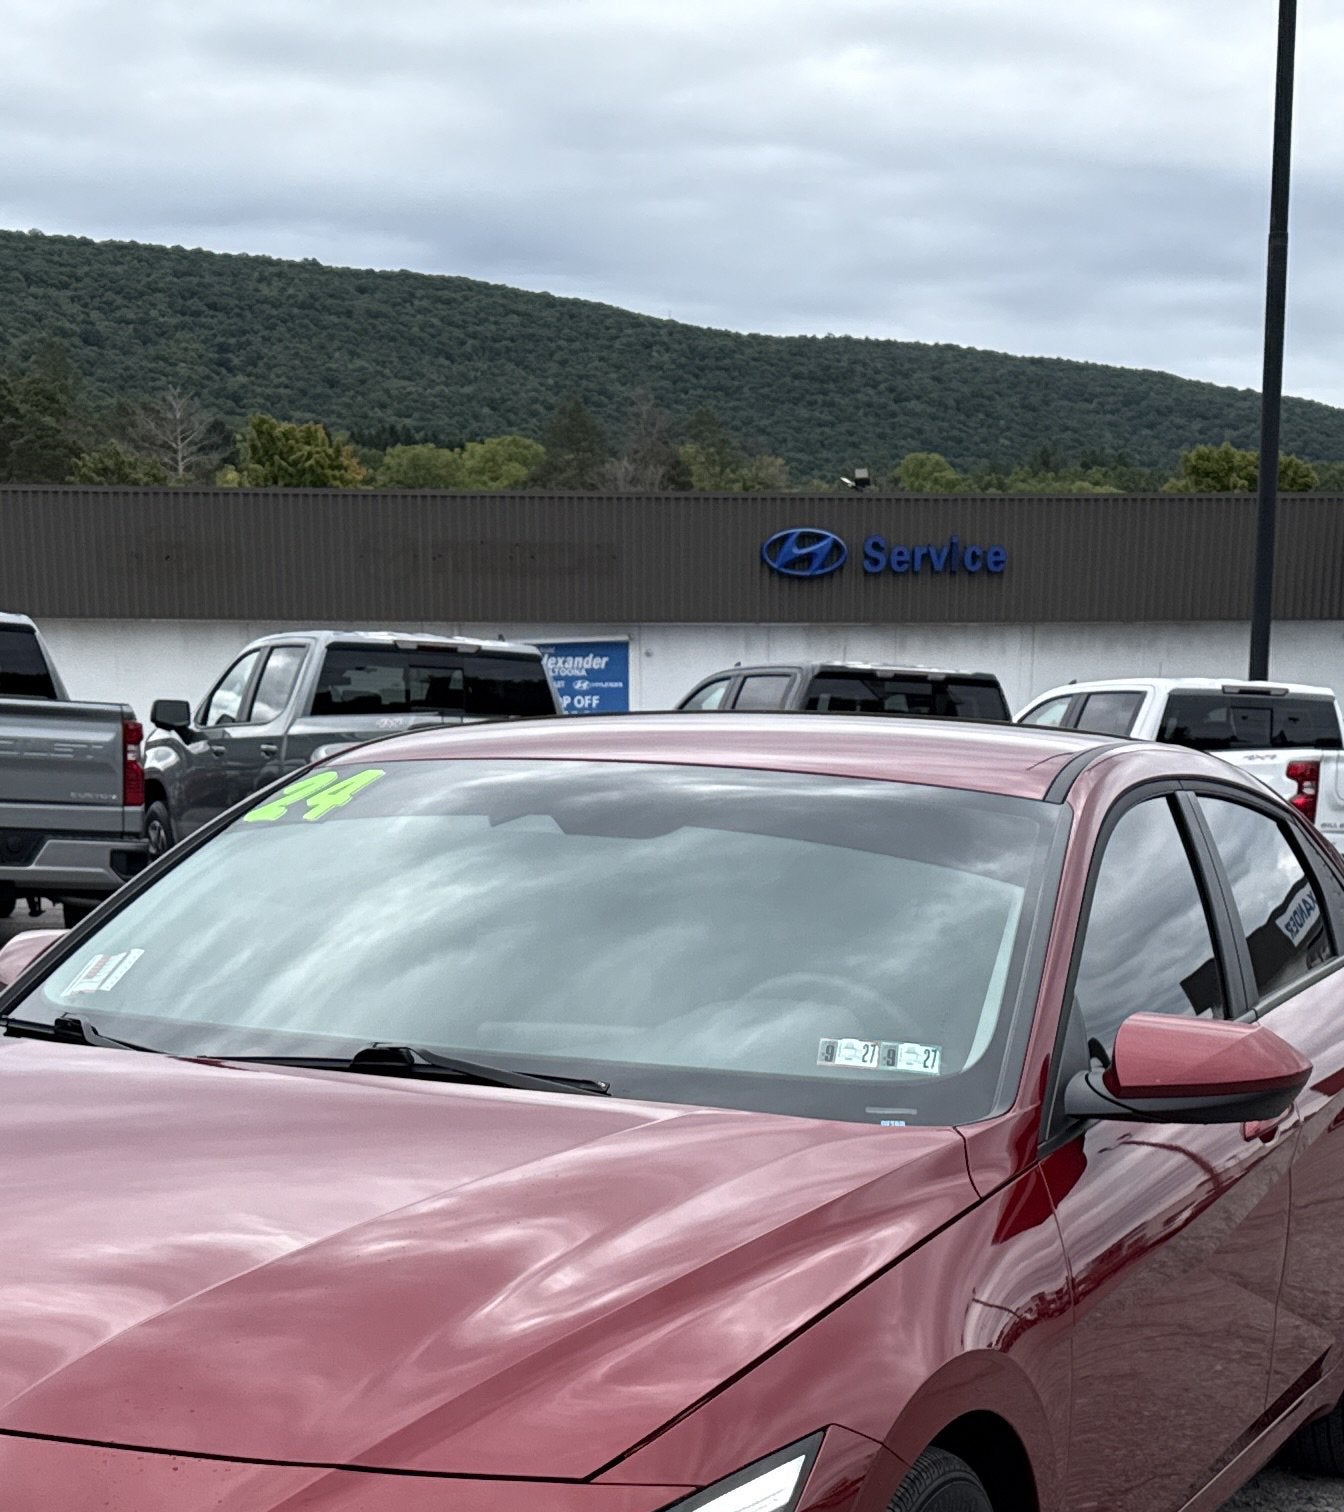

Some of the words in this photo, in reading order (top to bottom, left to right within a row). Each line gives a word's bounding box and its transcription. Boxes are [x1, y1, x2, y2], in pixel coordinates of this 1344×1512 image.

[863, 533, 1007, 573] Service
[541, 653, 610, 669] lexander
[549, 667, 588, 677] LTOONA
[573, 695, 601, 709] OFF
[243, 769, 387, 823] 24
[824, 1044, 835, 1063] 9
[861, 1043, 877, 1065] 27
[886, 1048, 897, 1067] 9
[923, 1048, 939, 1069] 27
